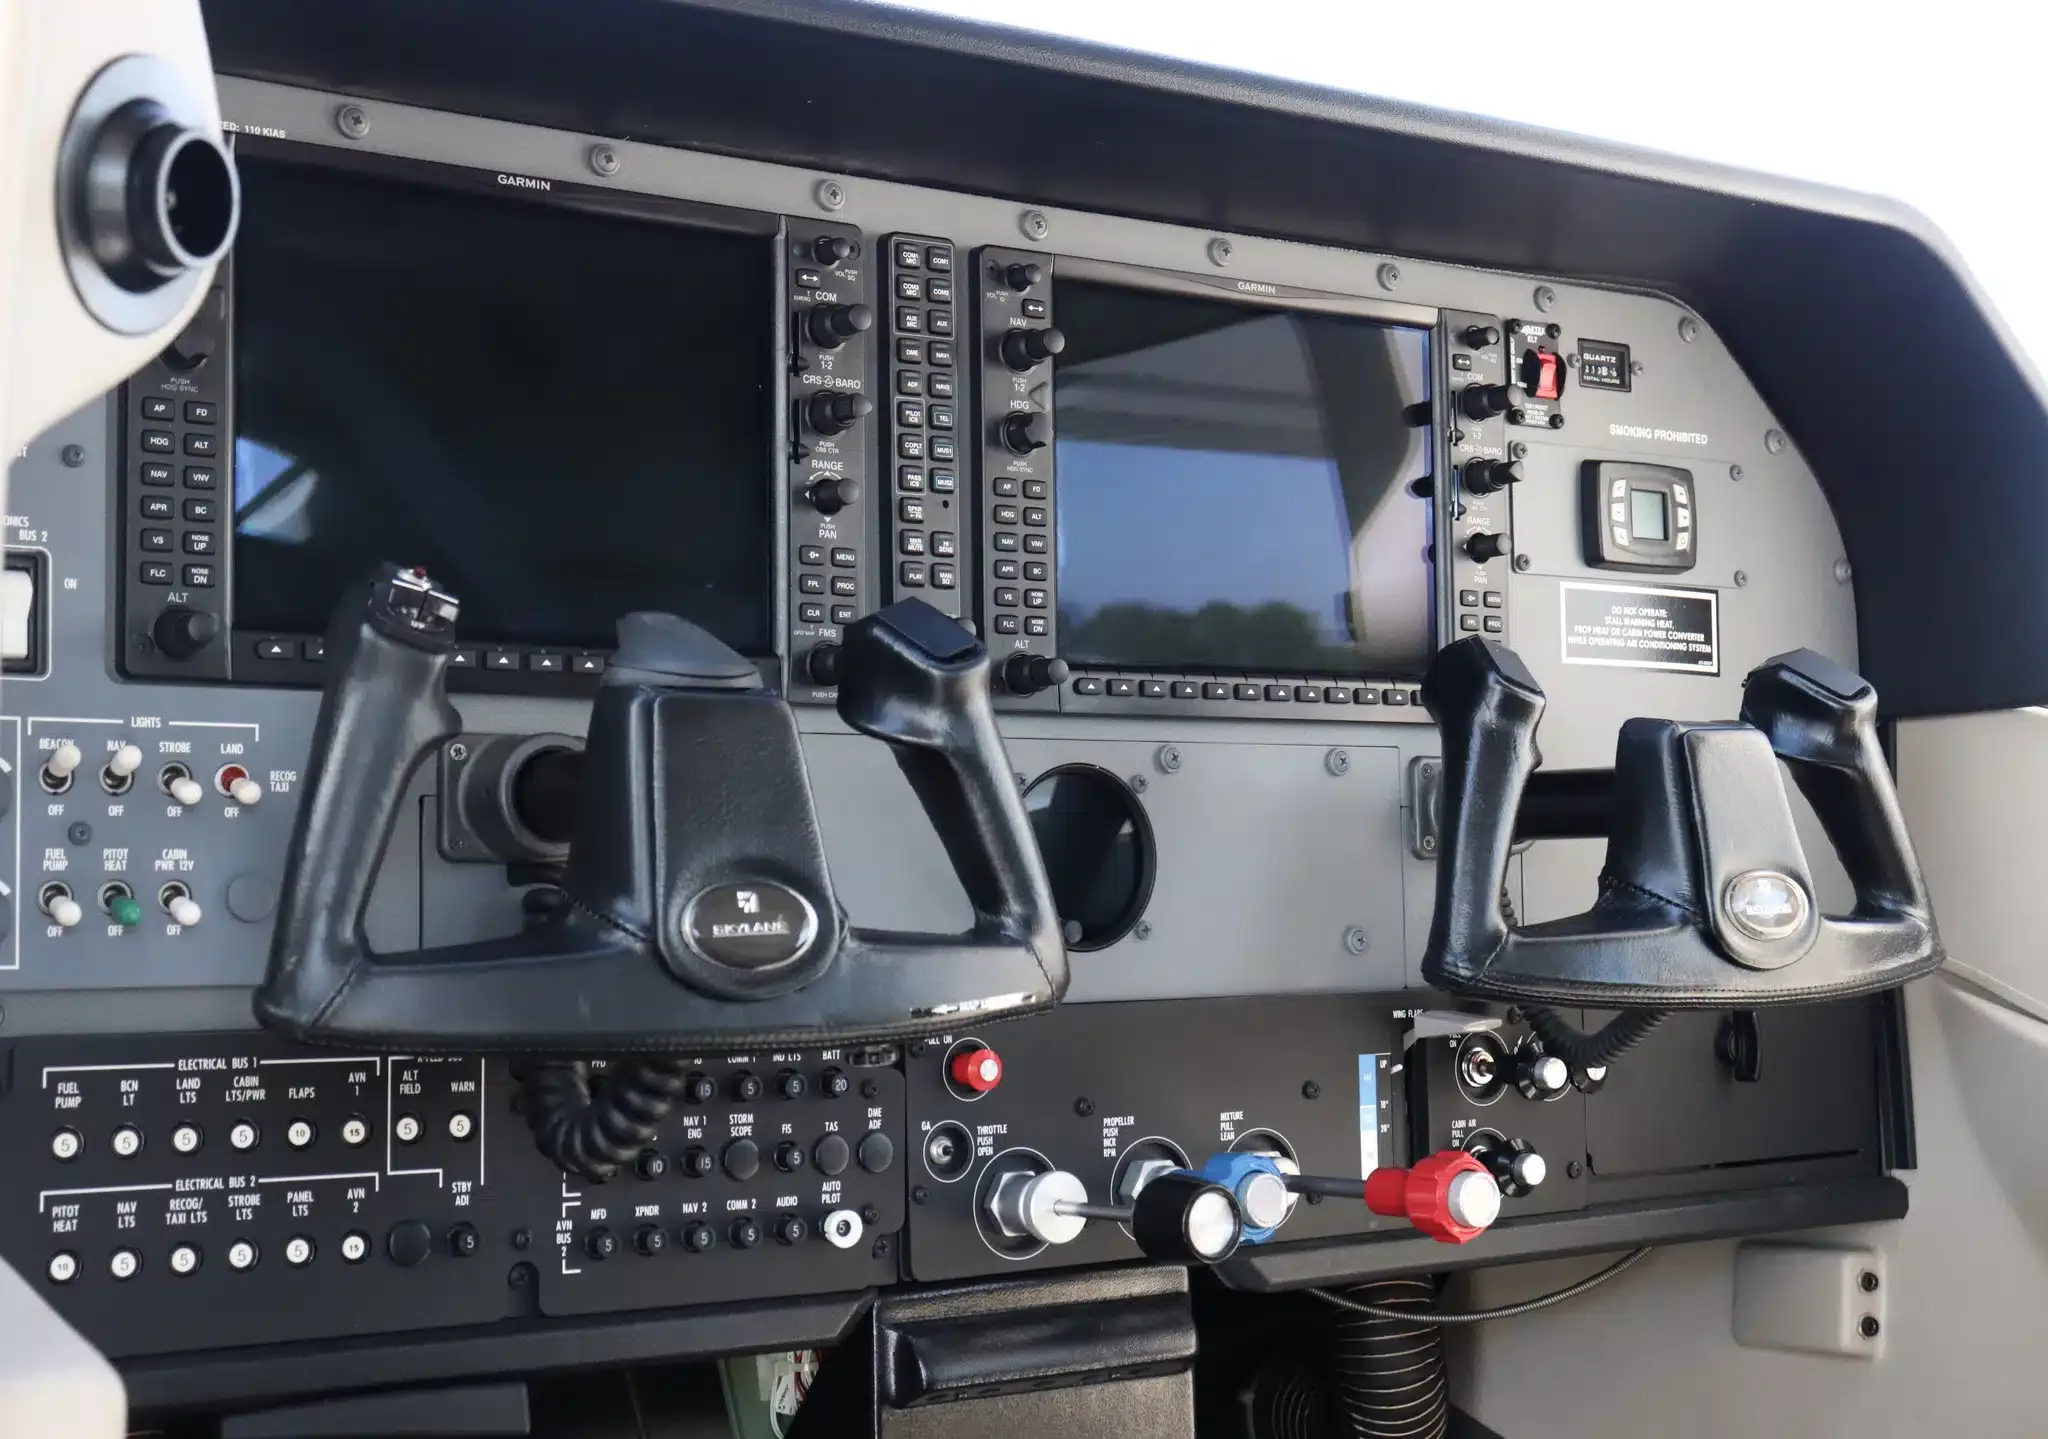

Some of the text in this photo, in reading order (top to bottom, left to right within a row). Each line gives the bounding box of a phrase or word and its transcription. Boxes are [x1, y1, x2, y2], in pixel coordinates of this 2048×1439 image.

[244, 125, 286, 139] 110 KIAS
[497, 174, 550, 191] GARMIN
[1237, 281, 1276, 294] GARMIN
[815, 291, 837, 302] COM
[1010, 317, 1027, 327] NAV
[821, 361, 833, 370] 1-2
[803, 374, 861, 389] CRS BARO
[154, 404, 165, 412] AP
[1010, 400, 1029, 410] HDG
[1609, 424, 1708, 444] SMOKING PROHIBITED
[150, 437, 169, 446] HDG
[194, 441, 209, 449] ALT
[811, 459, 844, 471] RANGE
[150, 470, 168, 478] NAV
[193, 474, 210, 482] VNV
[150, 503, 167, 511] APR
[19, 529, 48, 542] BUS 2
[819, 529, 837, 539] PAN
[153, 536, 164, 544] VS
[194, 542, 207, 550] UP
[836, 553, 855, 561] MENU
[150, 569, 166, 578] FLC
[63, 578, 77, 589] ON
[194, 575, 207, 584] DN
[807, 580, 820, 588] FPL
[836, 582, 855, 590] PROC
[167, 592, 189, 602] ALT
[807, 609, 820, 617] CLR
[839, 611, 852, 619] ENT
[818, 628, 837, 638] FMS
[1668, 631, 1705, 642] CONVERTER
[1688, 644, 1711, 653] SYSTEM
[131, 716, 161, 728] LIGHTS
[107, 740, 126, 751] NAV
[159, 742, 192, 753] STROBE
[220, 743, 244, 755] LAND
[270, 770, 297, 781] RECOG
[270, 782, 289, 793] TAXI
[48, 804, 65, 816] OFF
[45, 848, 66, 860] FUEL
[103, 848, 129, 860] PITOT
[162, 848, 188, 860] CABIN
[43, 860, 68, 871] PUMP
[104, 860, 128, 871] HEAT
[155, 860, 195, 871] PWR 12V
[166, 924, 182, 936] OFF
[1393, 1010, 1406, 1019] WING
[1450, 1039, 1457, 1048] ON
[822, 1050, 840, 1060] BATT
[178, 1057, 258, 1071] ELECTRICAL BUS 1
[1380, 1060, 1387, 1069] UP
[348, 1072, 366, 1083] AVN
[402, 1070, 419, 1081] ALT
[120, 1080, 139, 1092] BCN
[176, 1077, 201, 1090] LAND
[233, 1076, 260, 1088] CABIN
[450, 1081, 475, 1093] WARN
[835, 1079, 848, 1091] 20
[57, 1082, 80, 1094] FUEL
[288, 1087, 315, 1099] FLAPS
[399, 1083, 421, 1095] FIELD
[701, 1084, 711, 1096] 15
[123, 1094, 135, 1106] LT
[179, 1092, 197, 1104] LTS
[225, 1089, 266, 1102] LTS/PWR
[55, 1097, 82, 1109] PUMP
[867, 1107, 882, 1118] DME
[1220, 1110, 1244, 1122] MIXTURE
[683, 1115, 707, 1127] NAV 1
[729, 1113, 754, 1125] STORM
[868, 1119, 882, 1130] ADF
[1103, 1115, 1135, 1127] PROPELLER
[1468, 1119, 1477, 1127] AIR
[731, 1125, 752, 1137] SCOPE
[781, 1124, 792, 1134] FIS
[825, 1122, 839, 1132] TAS
[921, 1121, 931, 1131] GA
[977, 1124, 1008, 1135] THROTTLE
[1220, 1122, 1234, 1131] PULL
[240, 1130, 248, 1143] 5
[295, 1129, 306, 1138] 10
[687, 1128, 702, 1139] ENG
[1103, 1127, 1119, 1138] PUSH
[1220, 1132, 1235, 1142] LEAN
[1452, 1129, 1464, 1138] PULL
[977, 1136, 993, 1146] PUSH
[1103, 1138, 1116, 1148] INCR
[1452, 1139, 1460, 1148] ON
[977, 1146, 993, 1156] OPEN
[1103, 1148, 1116, 1158] RPM
[175, 1175, 256, 1192] ELECTRICAL BUS 2
[452, 1181, 472, 1193] STBY
[822, 1181, 841, 1191] AUTO
[287, 1191, 314, 1203] PANEL
[347, 1188, 365, 1199] AVN
[821, 1193, 841, 1204] PILOT
[169, 1197, 203, 1211] RECOG/
[228, 1194, 261, 1208] STROBE
[455, 1195, 469, 1206] ADI
[726, 1198, 756, 1211] COMM 2
[776, 1196, 798, 1207] AUDIO
[52, 1204, 80, 1218] PITOT
[117, 1201, 137, 1214] NAV
[292, 1205, 308, 1217] LTS
[635, 1205, 660, 1217] XPNDR
[682, 1202, 707, 1213] NAV 2
[165, 1211, 207, 1226] TAXI LTS
[591, 1209, 607, 1220] MFD
[53, 1219, 78, 1233] HEAT
[556, 1221, 573, 1231] AVN
[556, 1233, 571, 1244] BUS
[748, 1229, 755, 1241] 5
[238, 1250, 246, 1262] 5
[561, 1246, 567, 1257] 2
